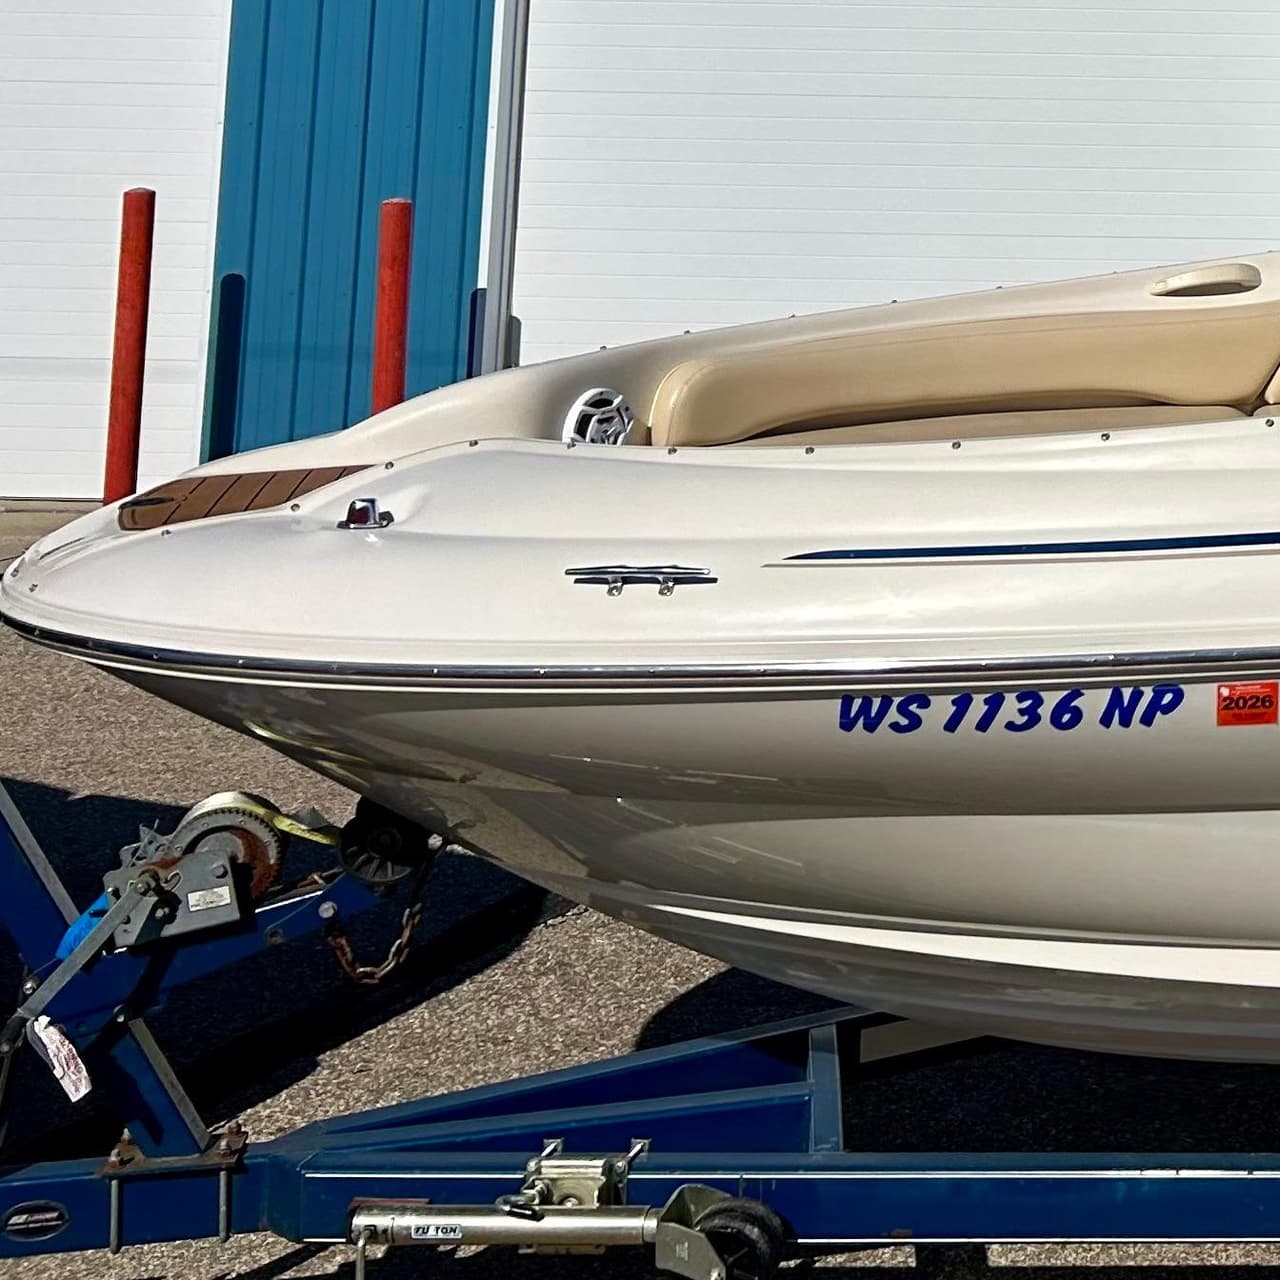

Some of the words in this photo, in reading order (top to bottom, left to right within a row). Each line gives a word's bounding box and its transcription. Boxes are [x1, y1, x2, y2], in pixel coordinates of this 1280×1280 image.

[839, 692, 932, 733] WS
[943, 689, 1084, 732] 1136
[1099, 683, 1184, 729] NP
[1221, 694, 1274, 711] 2026
[415, 1226, 458, 1235] FUTON
